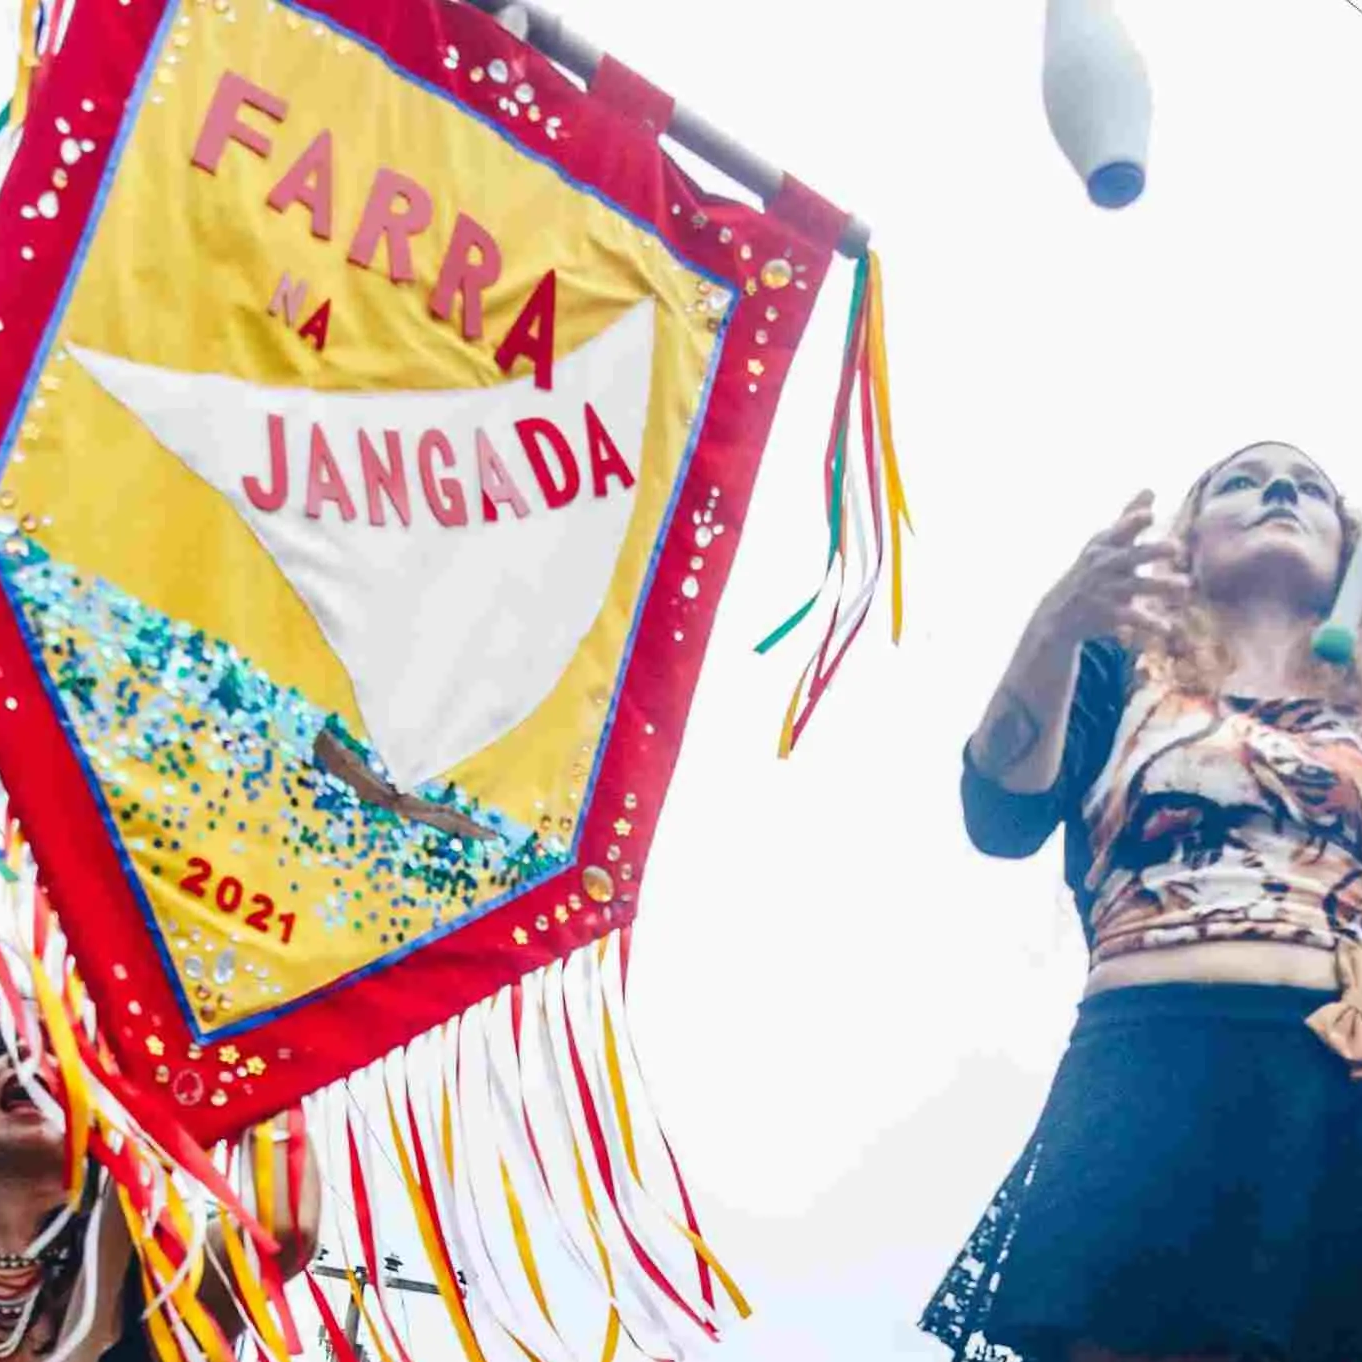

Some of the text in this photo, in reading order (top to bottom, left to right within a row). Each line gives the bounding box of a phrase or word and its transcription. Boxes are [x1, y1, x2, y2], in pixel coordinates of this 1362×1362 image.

[190, 70, 557, 391] FARRA
[267, 272, 333, 352] NA
[242, 402, 635, 528] JANGADA
[179, 856, 297, 945] 2021
